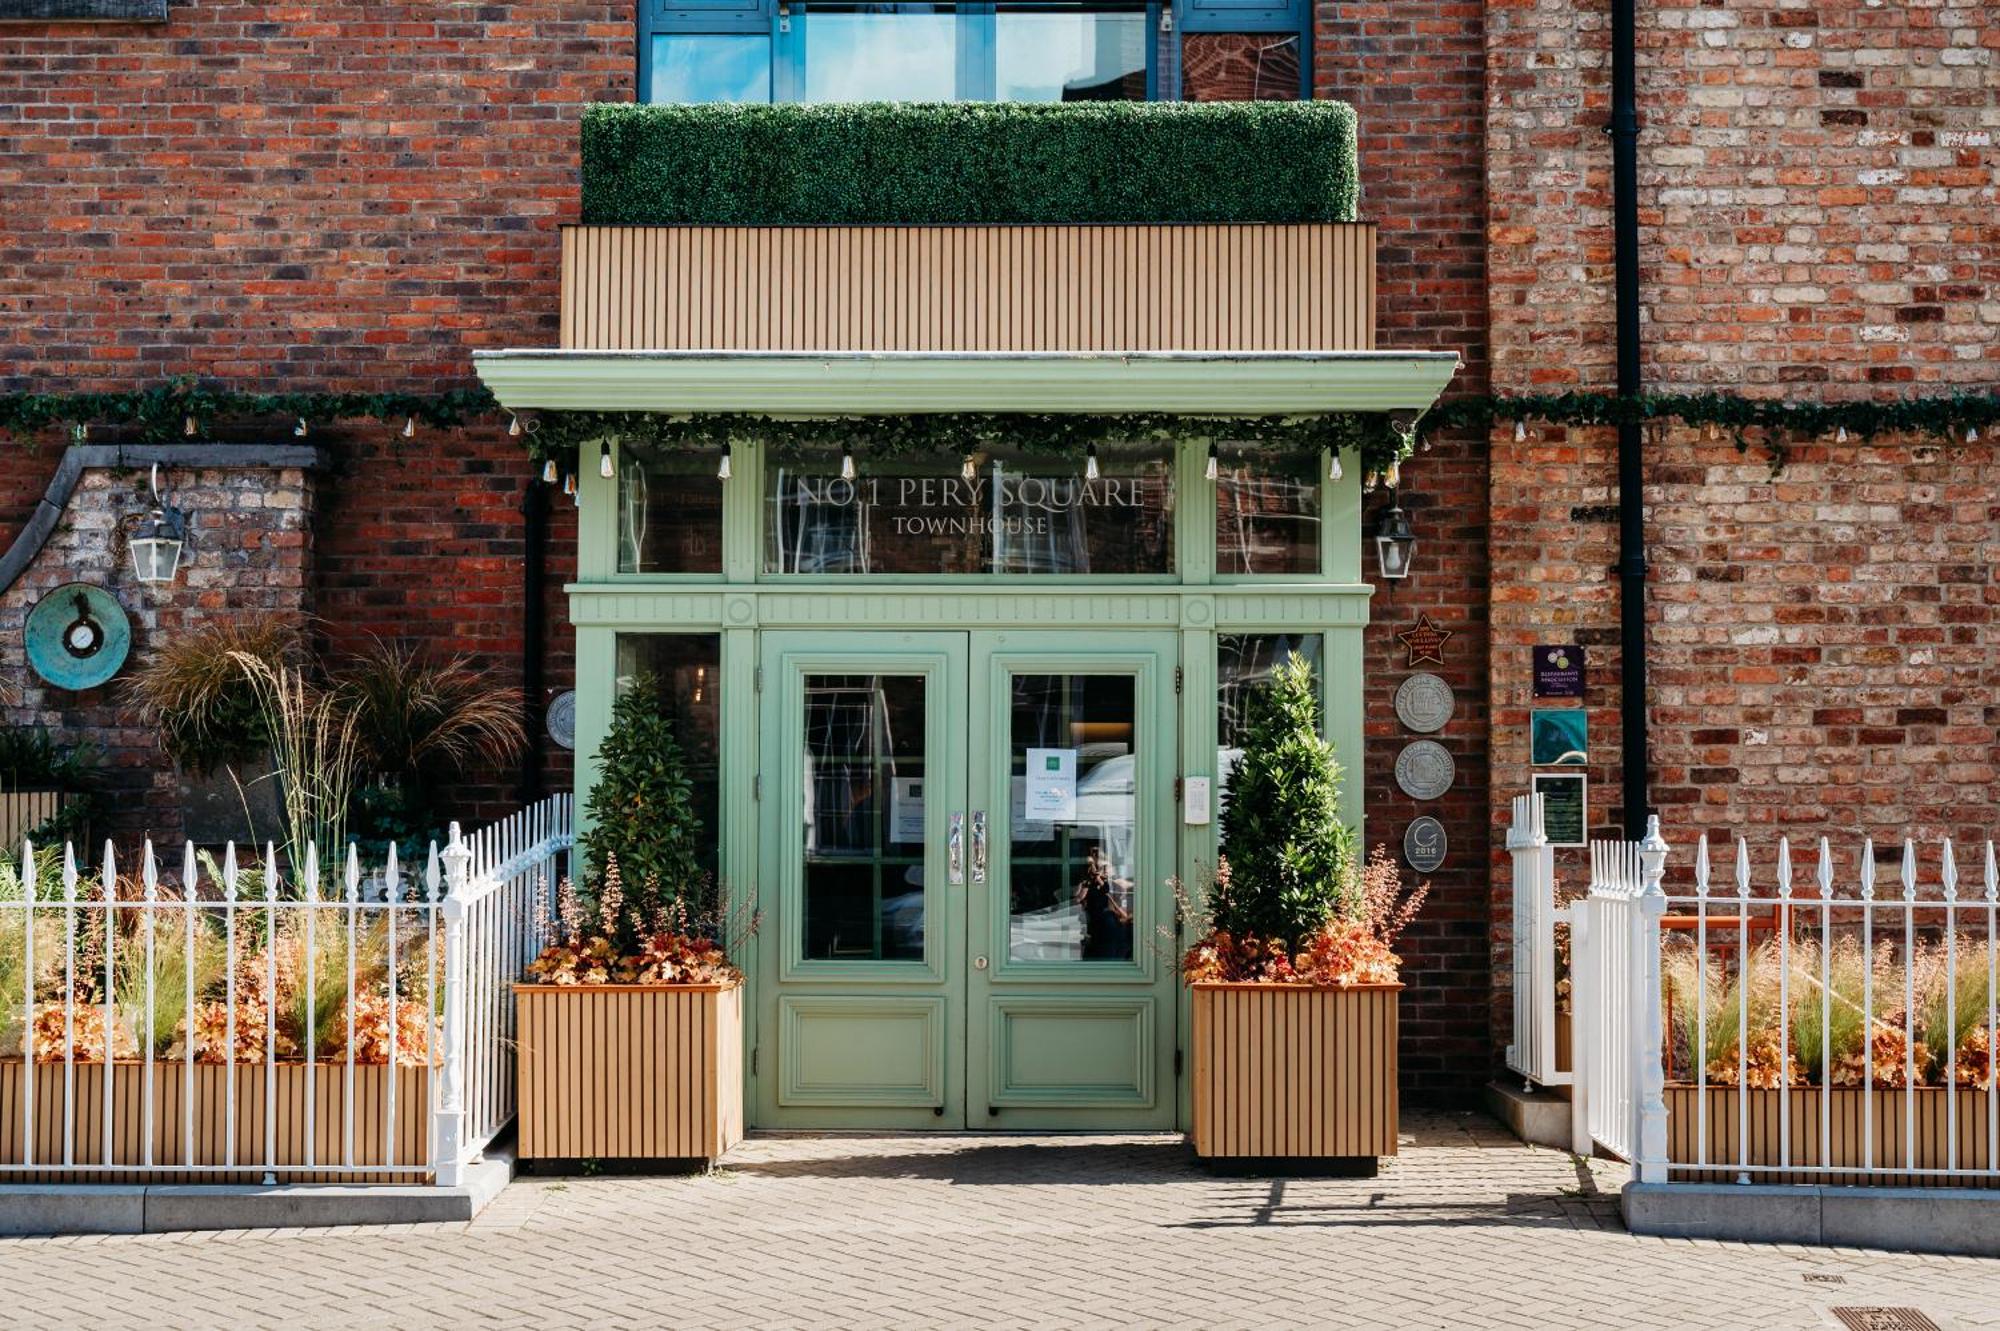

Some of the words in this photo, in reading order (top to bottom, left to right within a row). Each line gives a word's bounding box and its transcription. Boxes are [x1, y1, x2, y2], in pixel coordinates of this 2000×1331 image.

[898, 478, 987, 506] PERY
[999, 478, 1145, 513] SQUARE
[892, 516, 1047, 535] TOWNHOUSE
